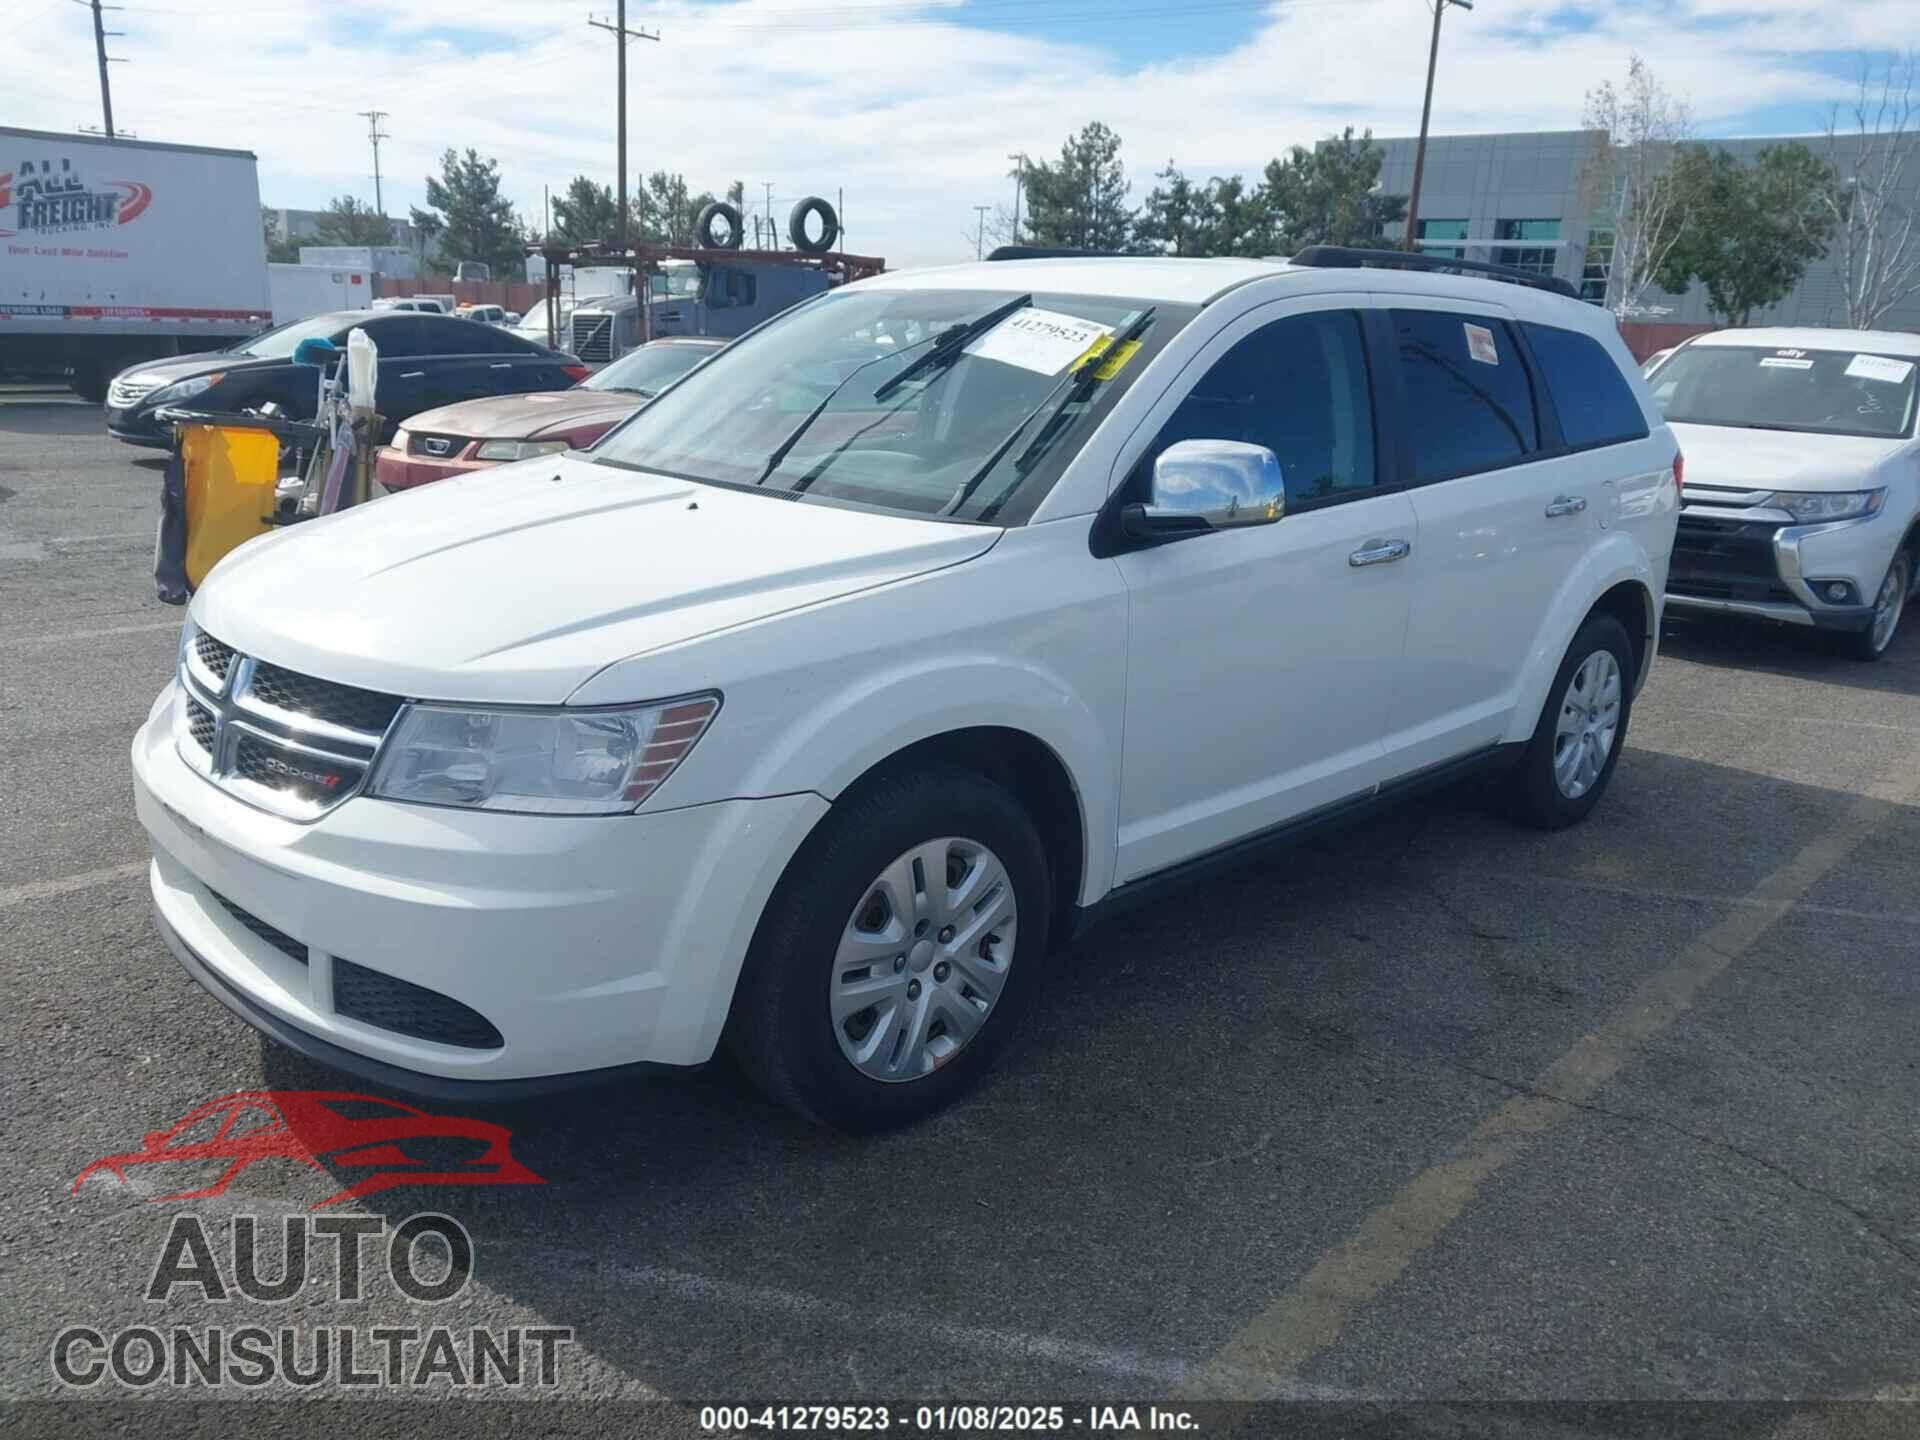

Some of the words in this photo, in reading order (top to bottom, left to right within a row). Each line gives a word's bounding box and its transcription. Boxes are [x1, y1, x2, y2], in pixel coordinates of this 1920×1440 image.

[17, 158, 84, 195] ALL
[17, 193, 120, 230] FREIGHT
[1013, 318, 1088, 342] 41279523
[265, 757, 327, 785] DODGE
